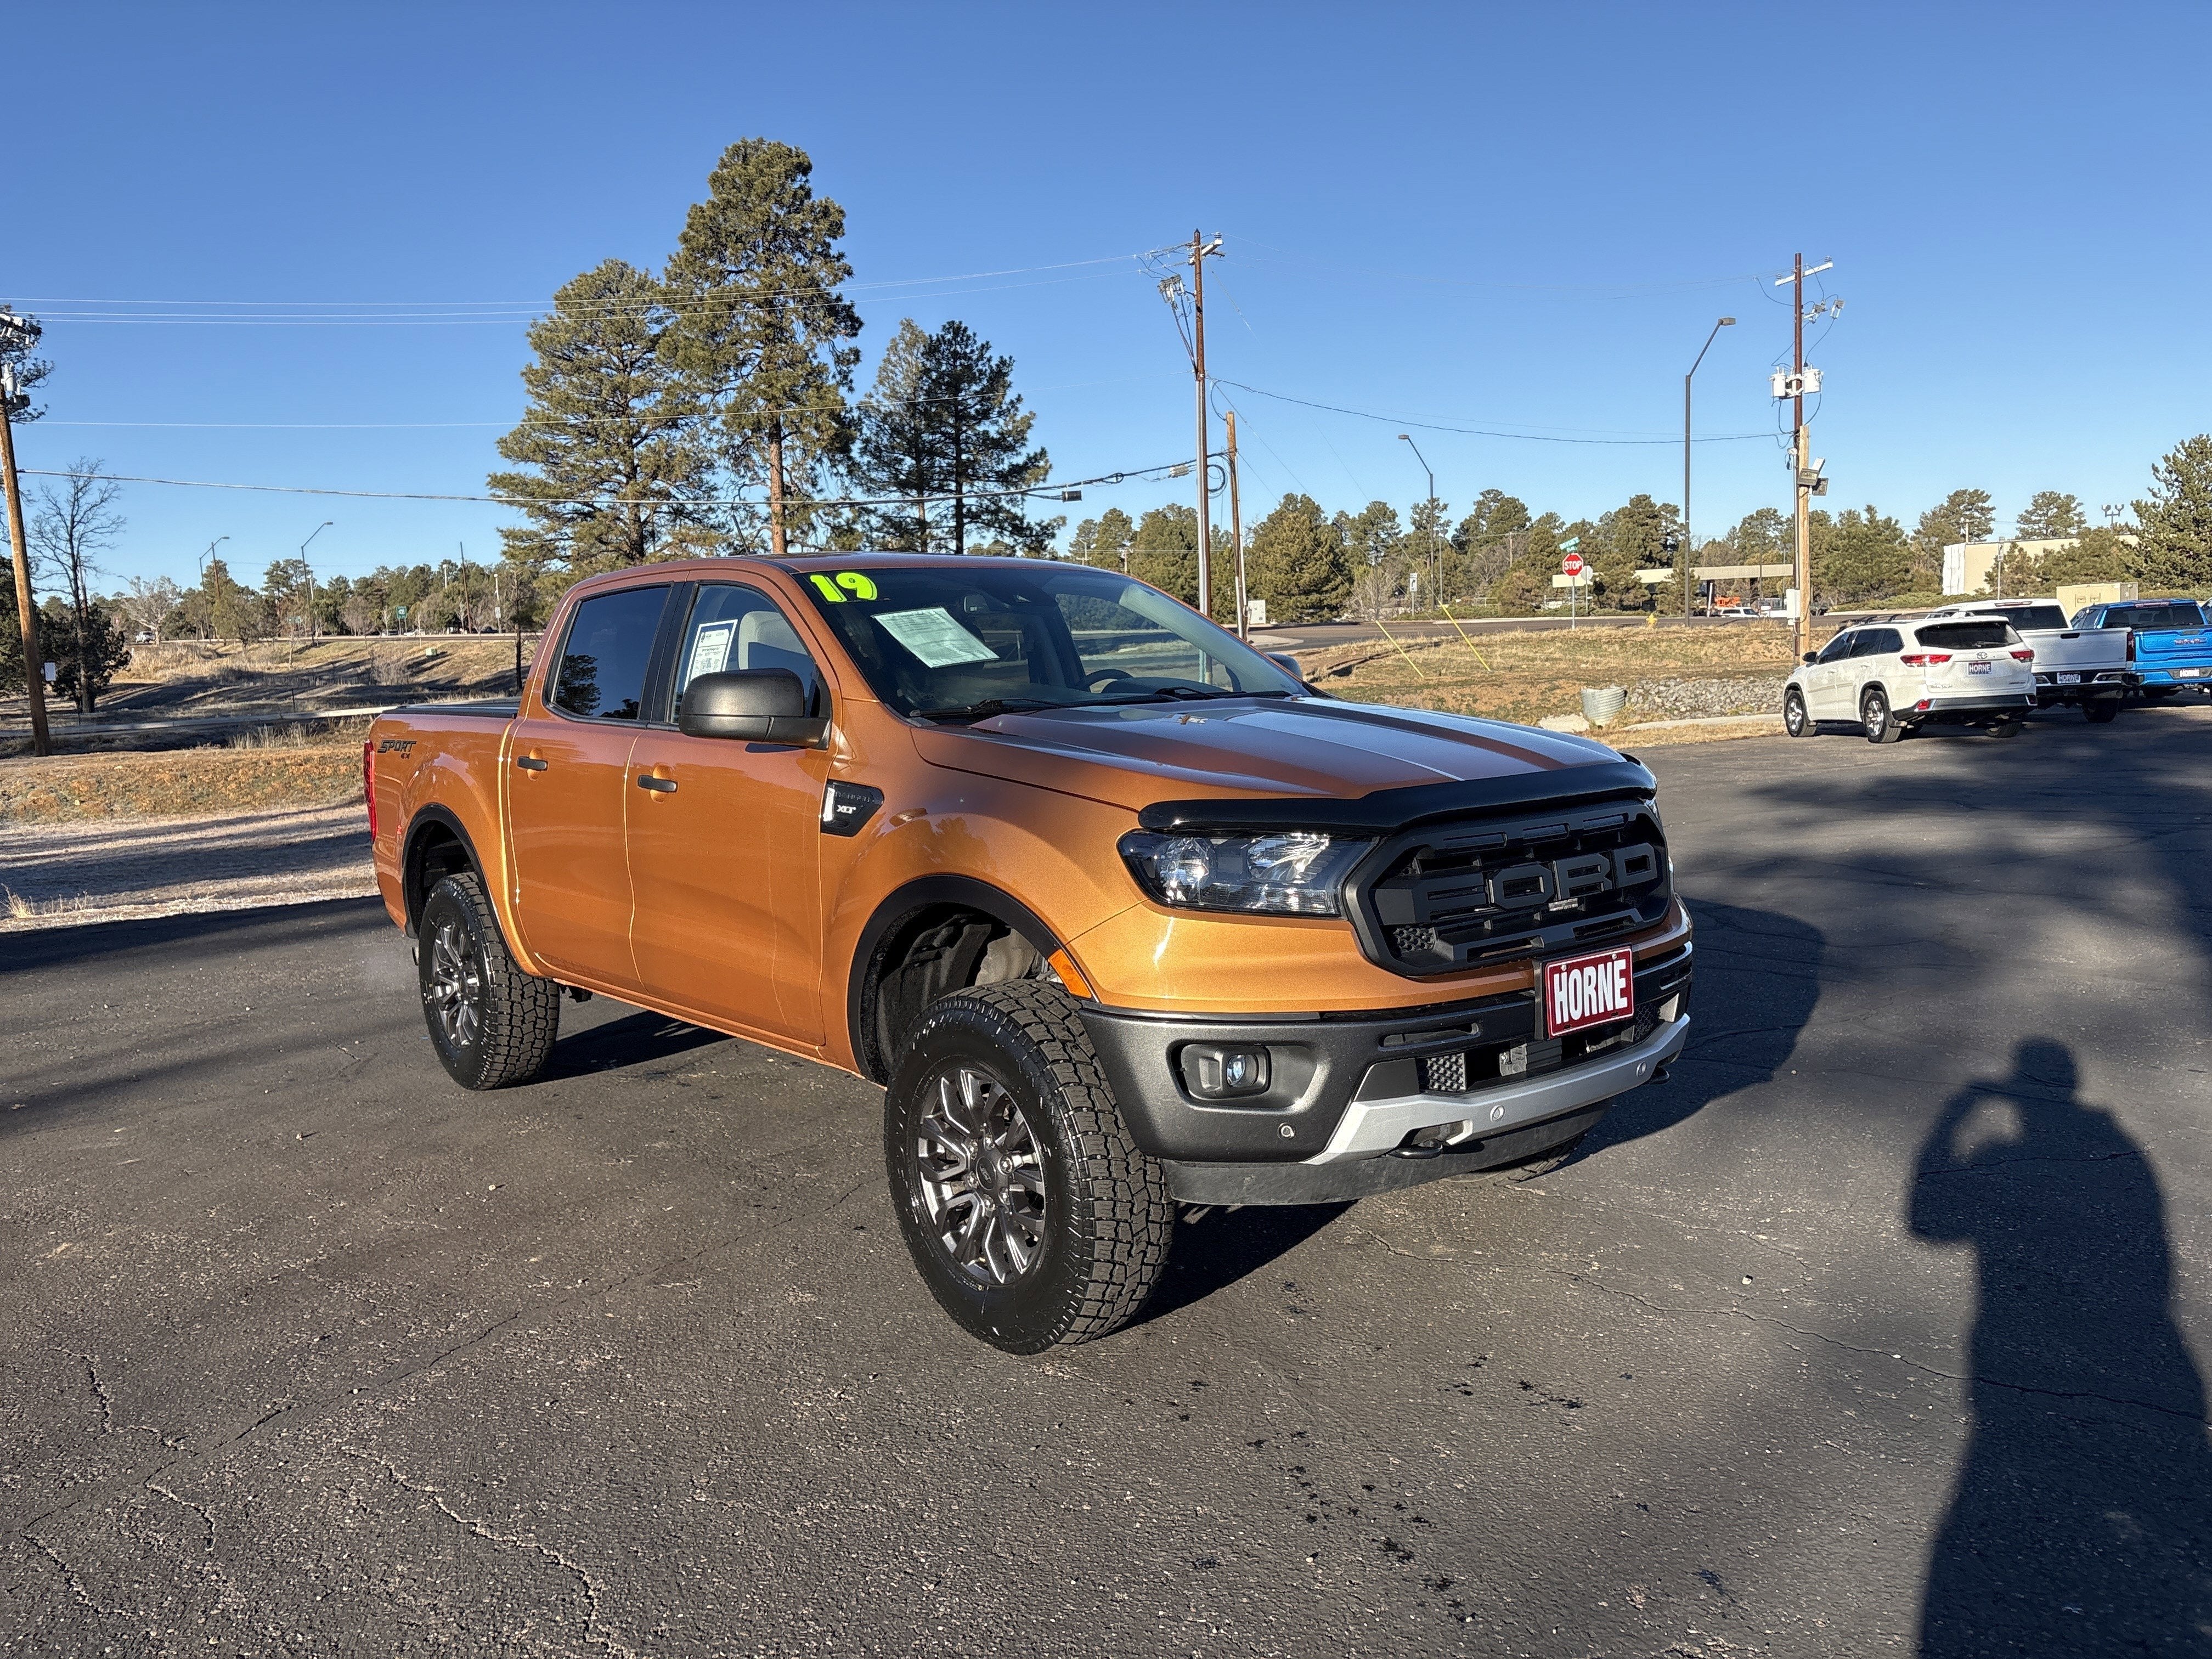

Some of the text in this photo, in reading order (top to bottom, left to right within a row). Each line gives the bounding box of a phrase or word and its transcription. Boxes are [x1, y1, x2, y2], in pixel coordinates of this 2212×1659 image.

[1564, 560, 1582, 571] STOP
[810, 572, 878, 602] 19
[1969, 663, 1991, 673] HORNE
[2180, 669, 2200, 678] HORNE
[377, 740, 417, 753] SPORT
[836, 804, 856, 814] XLT
[1404, 842, 1658, 926] FORD
[1553, 958, 1628, 1025] HORNE
